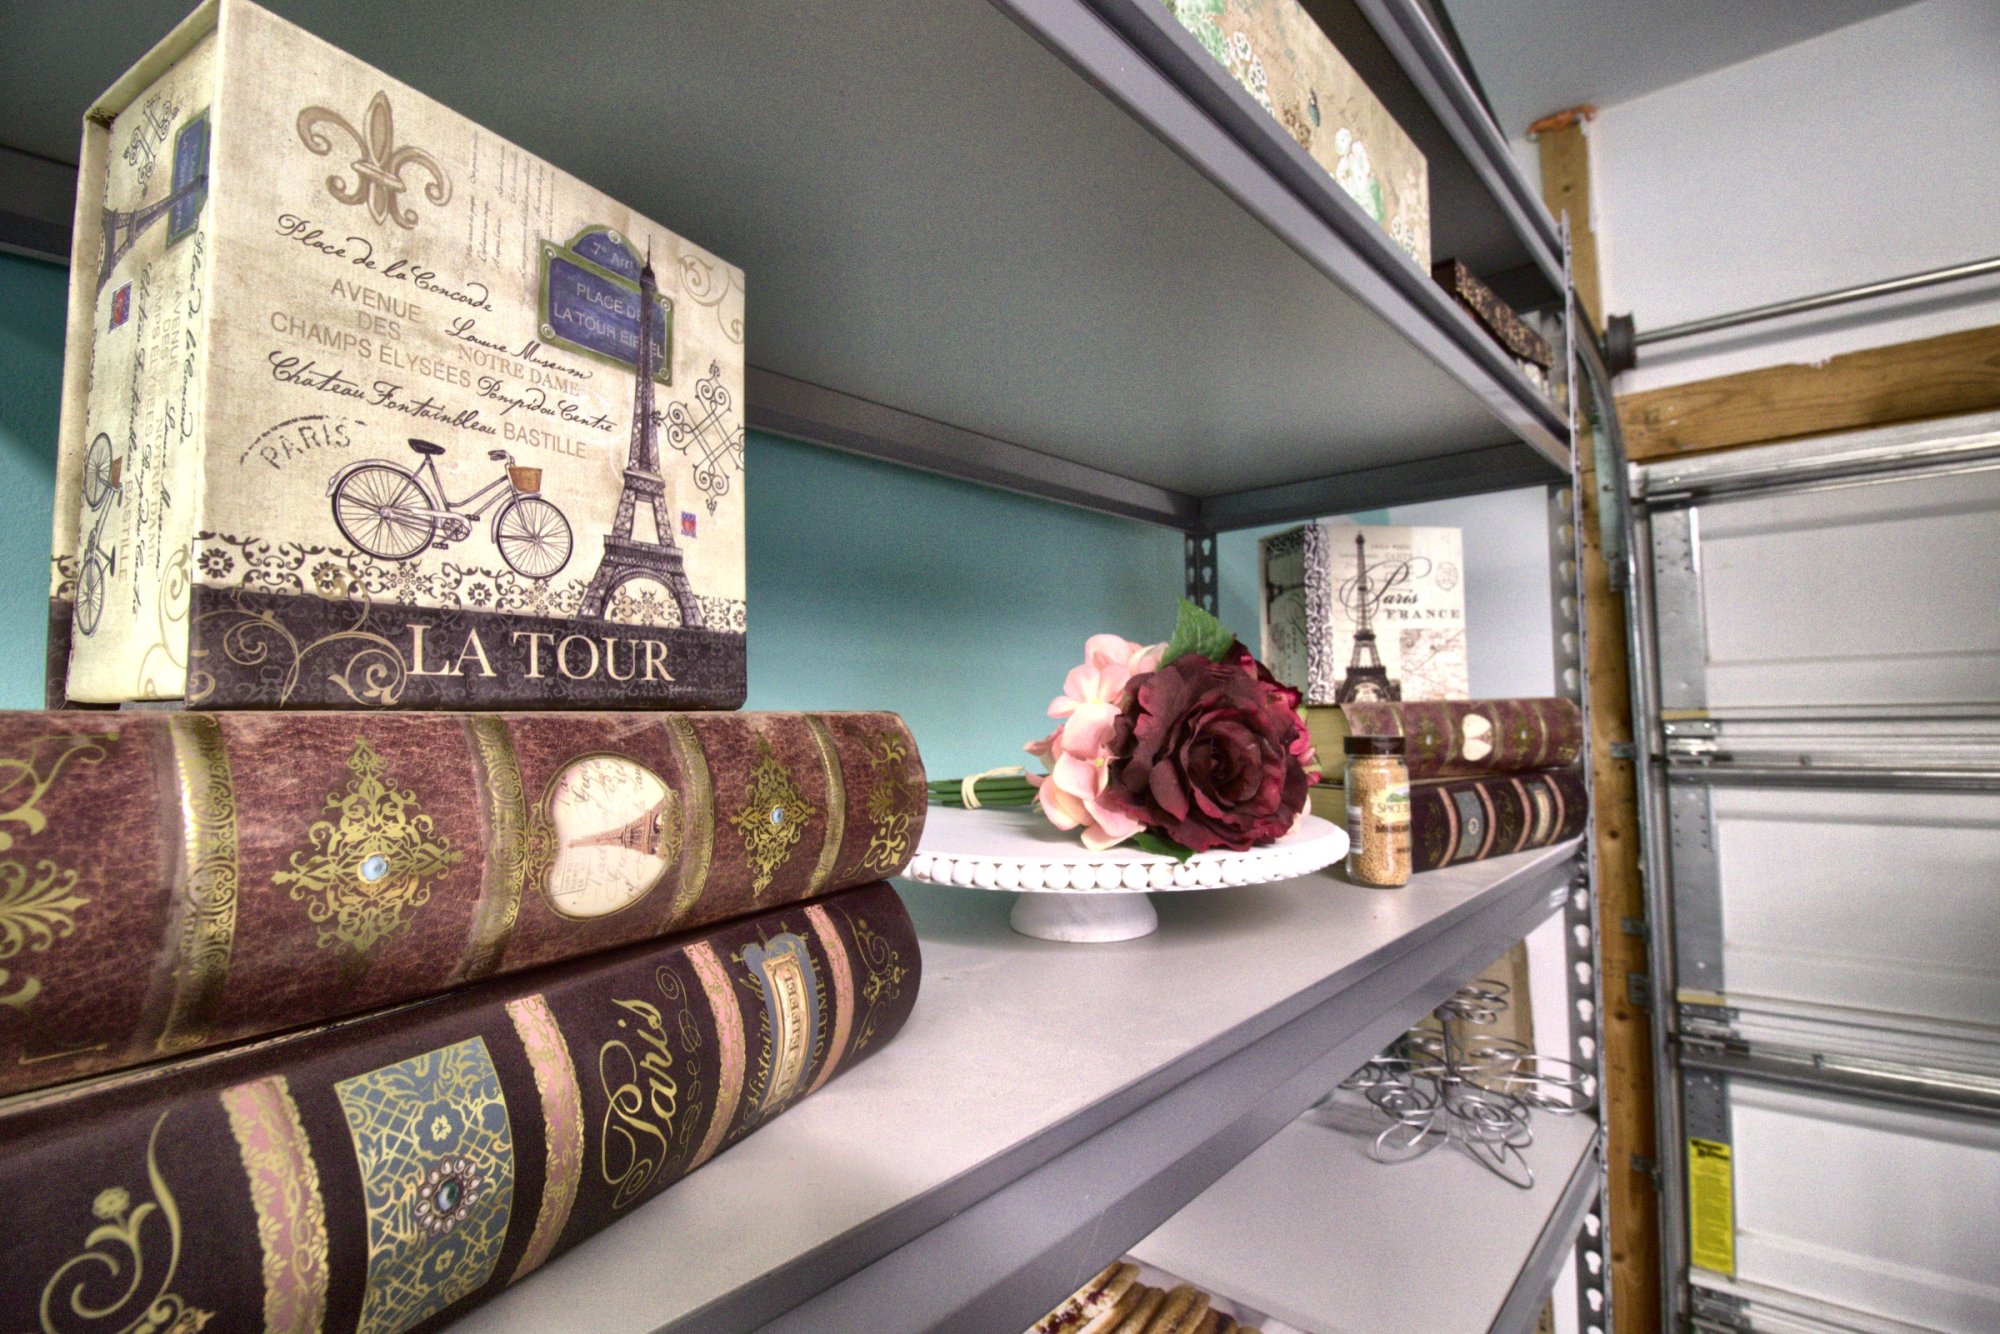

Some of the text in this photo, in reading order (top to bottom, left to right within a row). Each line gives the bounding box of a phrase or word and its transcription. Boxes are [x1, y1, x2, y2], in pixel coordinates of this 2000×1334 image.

[276, 214, 493, 312] Place de la Concorde
[331, 278, 424, 324] AVENUE
[576, 283, 625, 315] PLACE
[270, 311, 372, 358] CHAMPS
[357, 311, 401, 341] DES
[445, 317, 593, 379] Louvre Museum
[554, 303, 664, 359] LA TOUR EIFEL
[268, 350, 364, 400] Chateau
[457, 344, 580, 397] NOTRE DAME
[476, 376, 617, 432] Pompidou Centre
[260, 423, 351, 470] PARIS
[503, 422, 587, 459] BASTILLE
[1339, 556, 1432, 623] Paris
[1384, 608, 1461, 620] FRANCE
[406, 624, 675, 682] LA TOUR
[739, 972, 767, 1002] de
[784, 972, 800, 1052] EIFFEL
[808, 979, 828, 1072] VOLUME
[600, 998, 677, 1205] Paris
